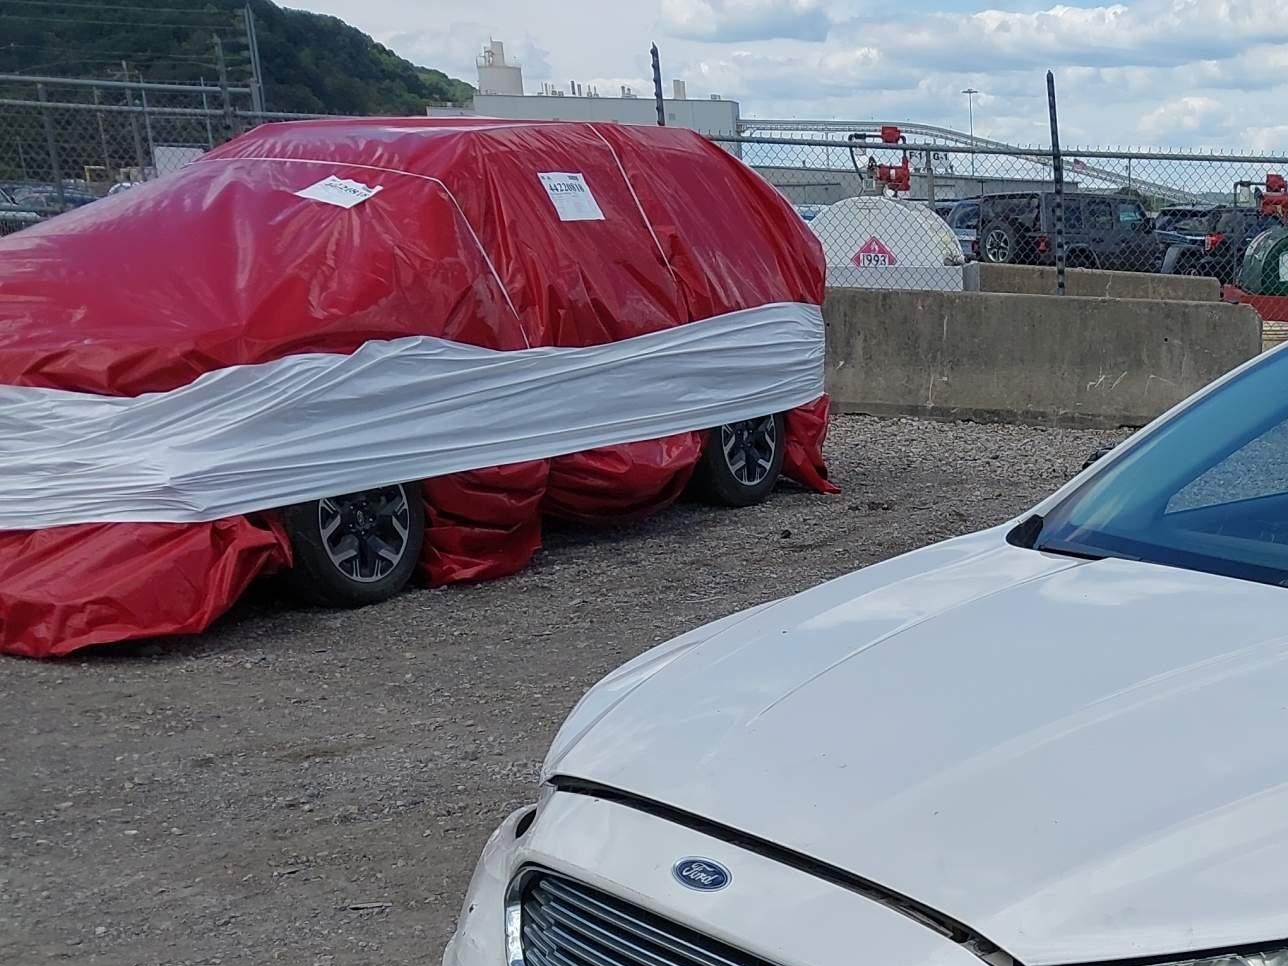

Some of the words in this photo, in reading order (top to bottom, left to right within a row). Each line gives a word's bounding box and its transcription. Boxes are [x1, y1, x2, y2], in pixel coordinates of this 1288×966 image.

[933, 152, 948, 161] G-1
[862, 254, 887, 267] 1993
[682, 862, 719, 885] Ford
